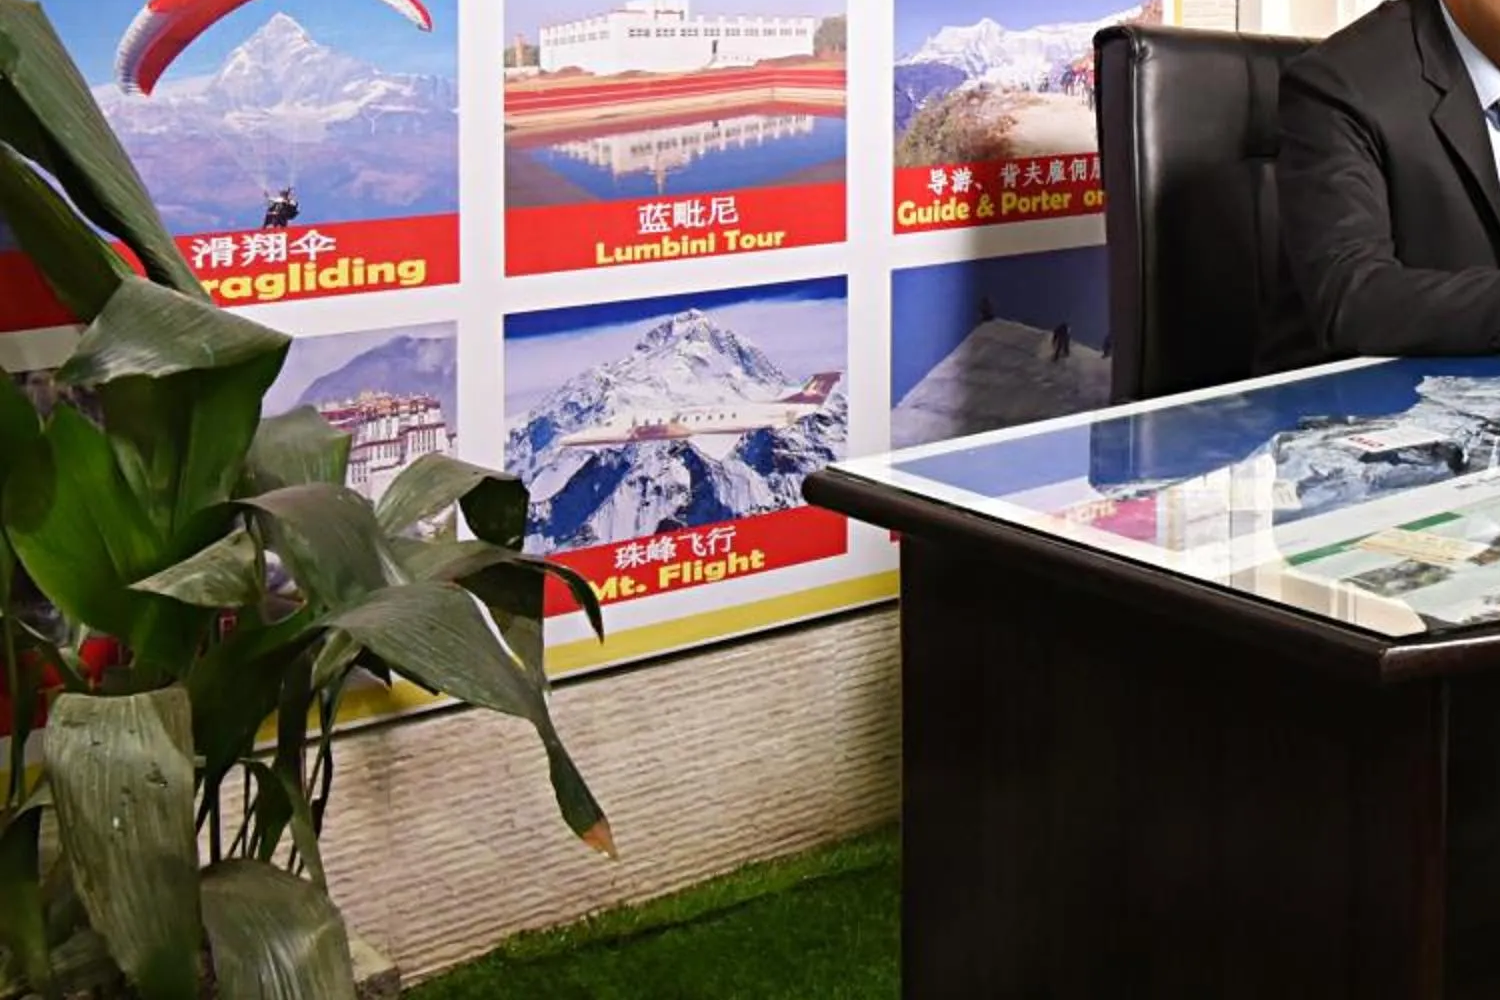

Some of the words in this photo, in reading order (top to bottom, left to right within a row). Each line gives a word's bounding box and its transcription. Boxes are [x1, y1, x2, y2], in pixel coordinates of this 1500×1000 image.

[637, 196, 739, 234] 蓝毗尼
[897, 197, 969, 225] Guide
[977, 194, 995, 217] &
[1001, 190, 1072, 215] Porter
[191, 229, 337, 268] 滑翔伞
[596, 233, 715, 264] Lumbini
[723, 229, 786, 250] Tour
[201, 257, 427, 300] ragliding
[614, 526, 736, 569] 珠峰飞行
[588, 575, 647, 600] Mt.
[659, 549, 765, 588] Flight
